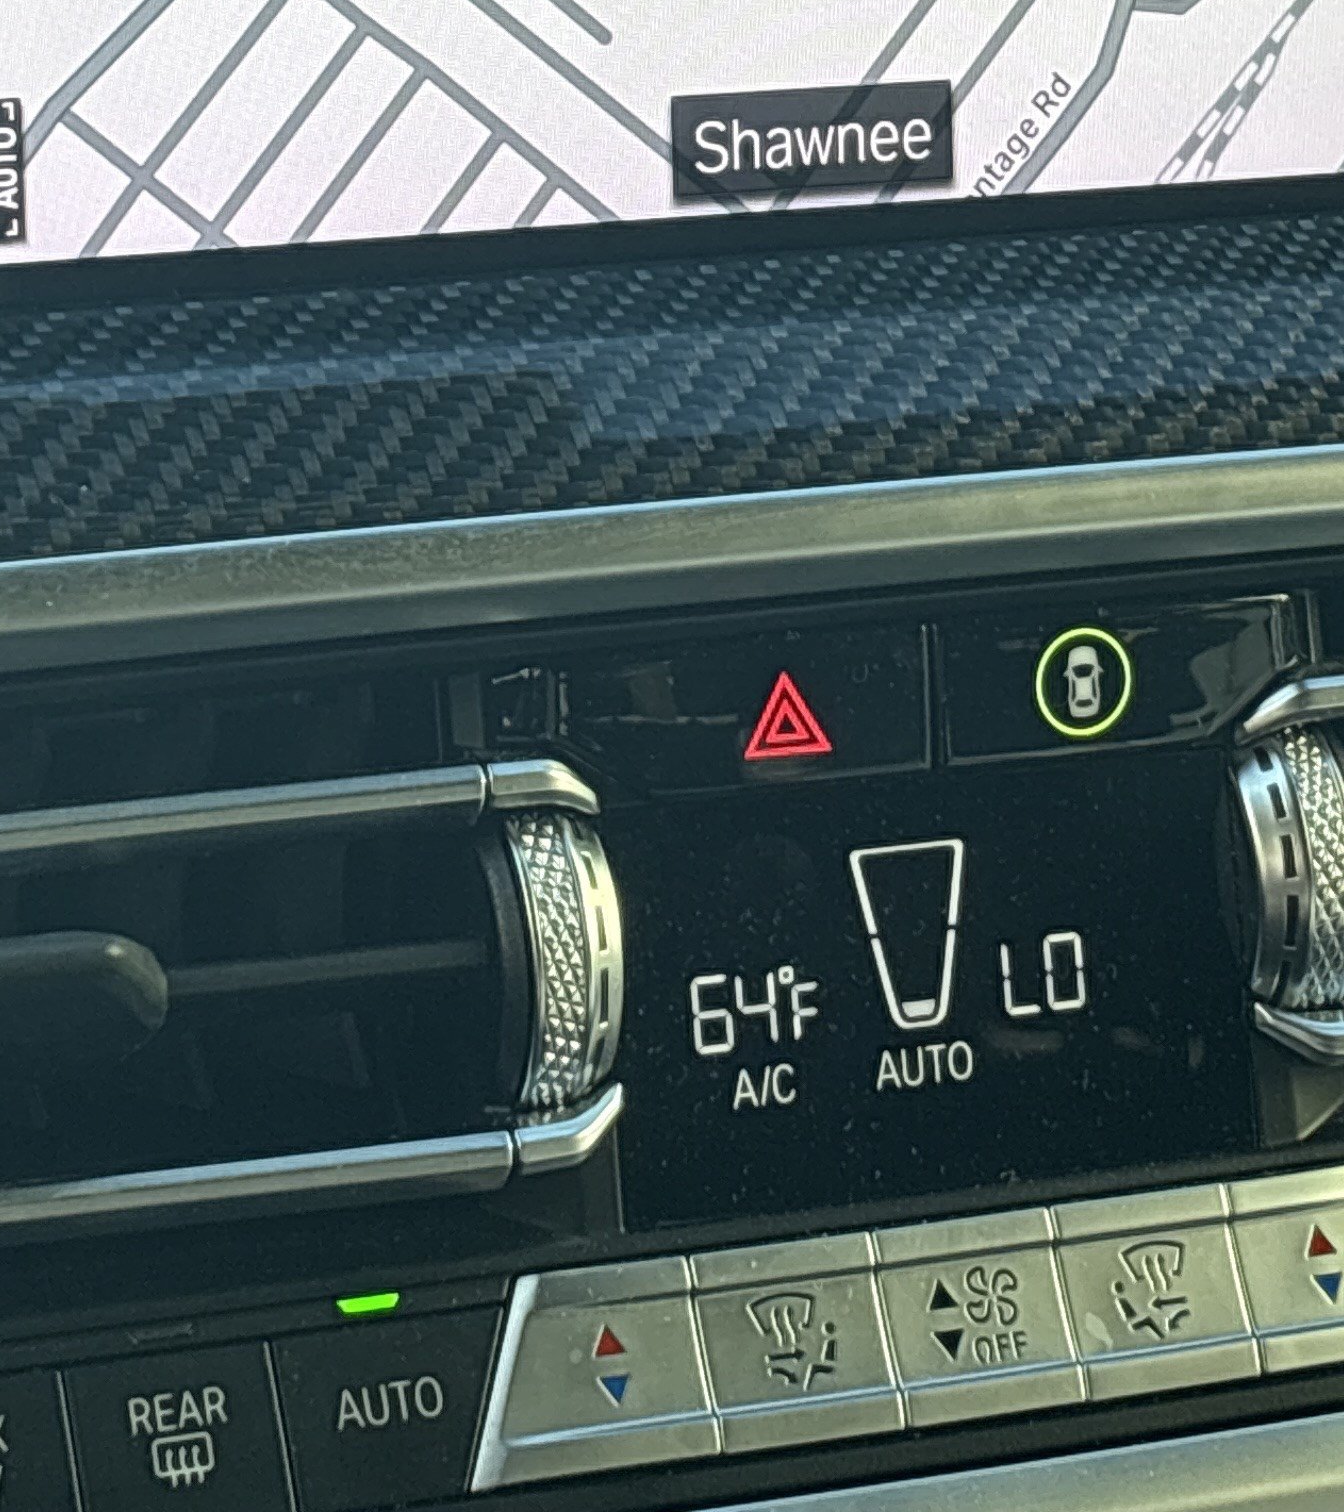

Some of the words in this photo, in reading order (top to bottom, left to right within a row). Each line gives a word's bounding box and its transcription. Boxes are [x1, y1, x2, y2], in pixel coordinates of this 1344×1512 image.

[694, 118, 932, 174] Shawnee
[967, 118, 1040, 198] ntage
[1031, 71, 1072, 118] Rd
[733, 1063, 796, 1110] A/C
[876, 1040, 973, 1091] AUTO
[971, 1330, 1028, 1364] OFF
[128, 1386, 228, 1435] REAR
[337, 1376, 444, 1431] AUTO
